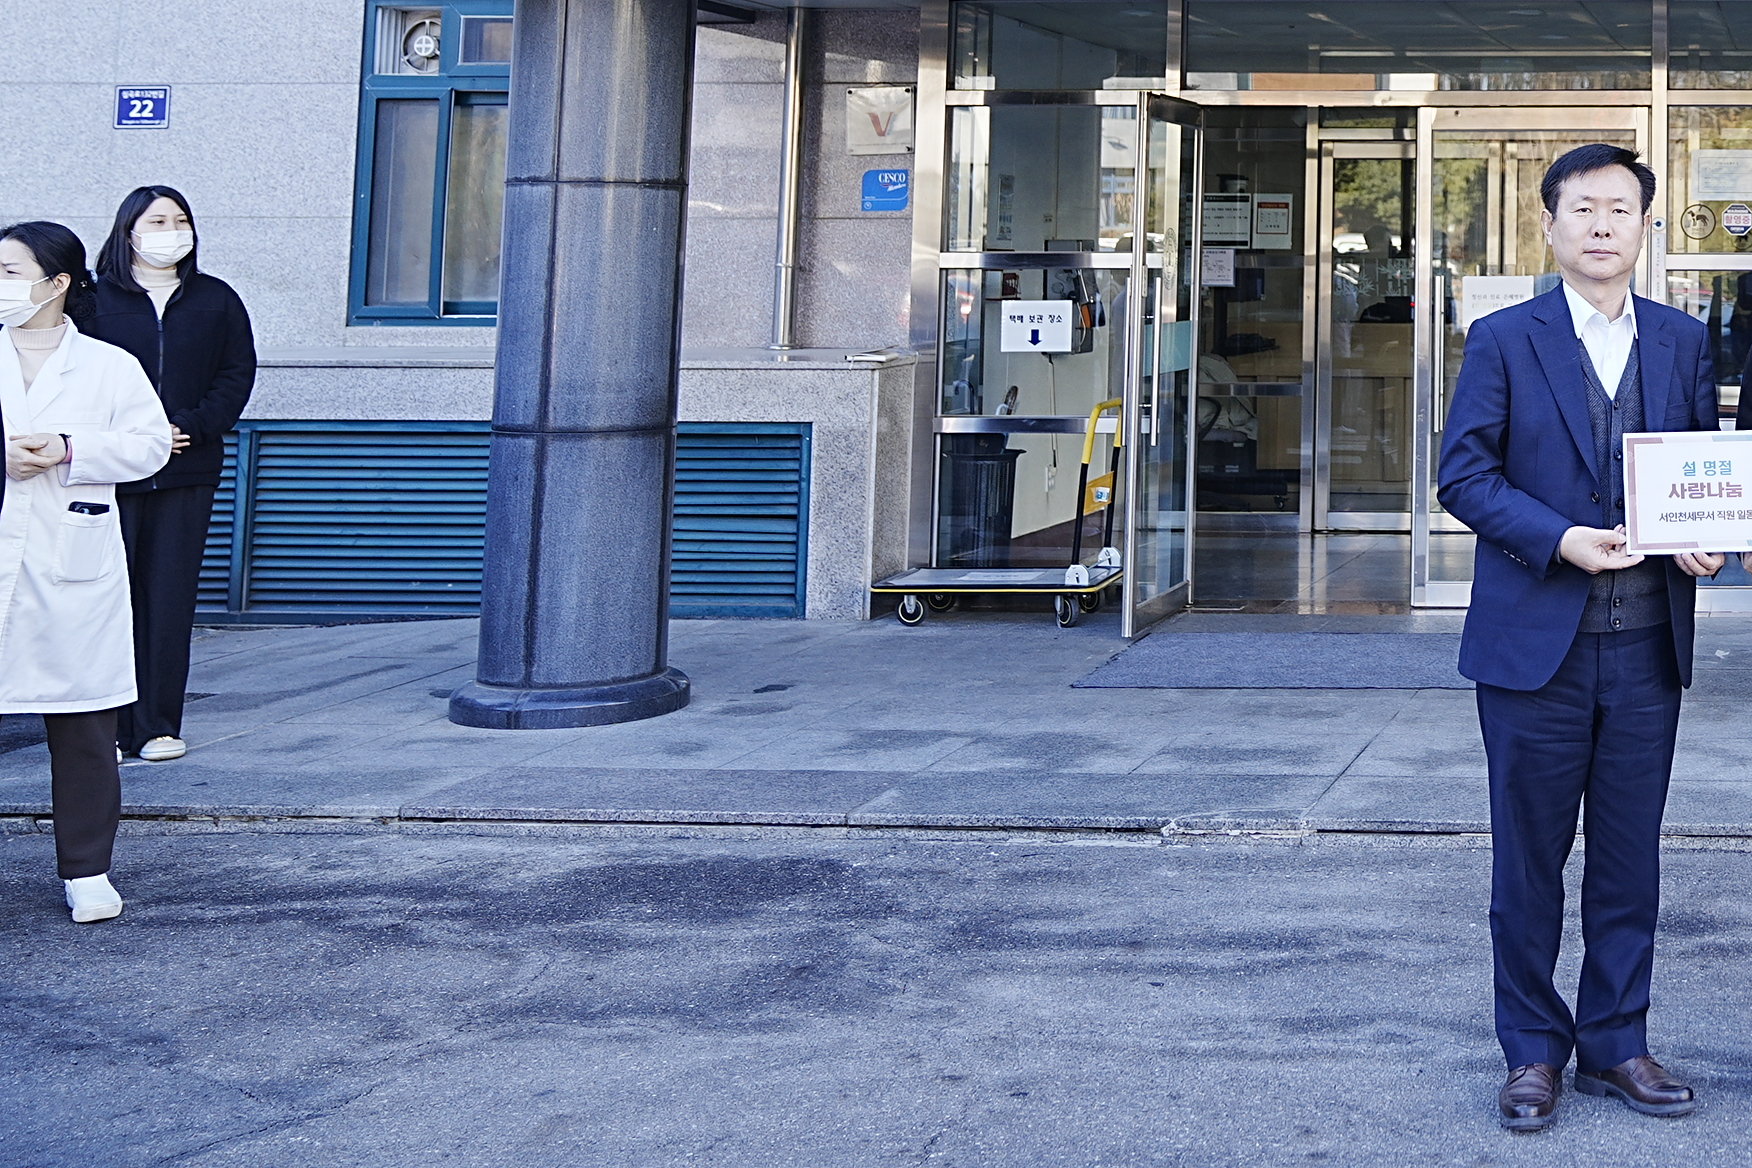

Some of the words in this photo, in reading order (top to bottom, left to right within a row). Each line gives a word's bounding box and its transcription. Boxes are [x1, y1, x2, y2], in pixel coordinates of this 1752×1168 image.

[129, 99, 154, 118] 22
[878, 172, 906, 183] CESCO
[1725, 215, 1750, 225] 촬영중
[1048, 314, 1063, 324] 장소
[1682, 461, 1696, 477] 설
[1703, 460, 1732, 476] 명절
[1668, 481, 1743, 500] 사랑나눔
[1659, 511, 1715, 523] 서인천세무서
[1716, 510, 1735, 521] 직원
